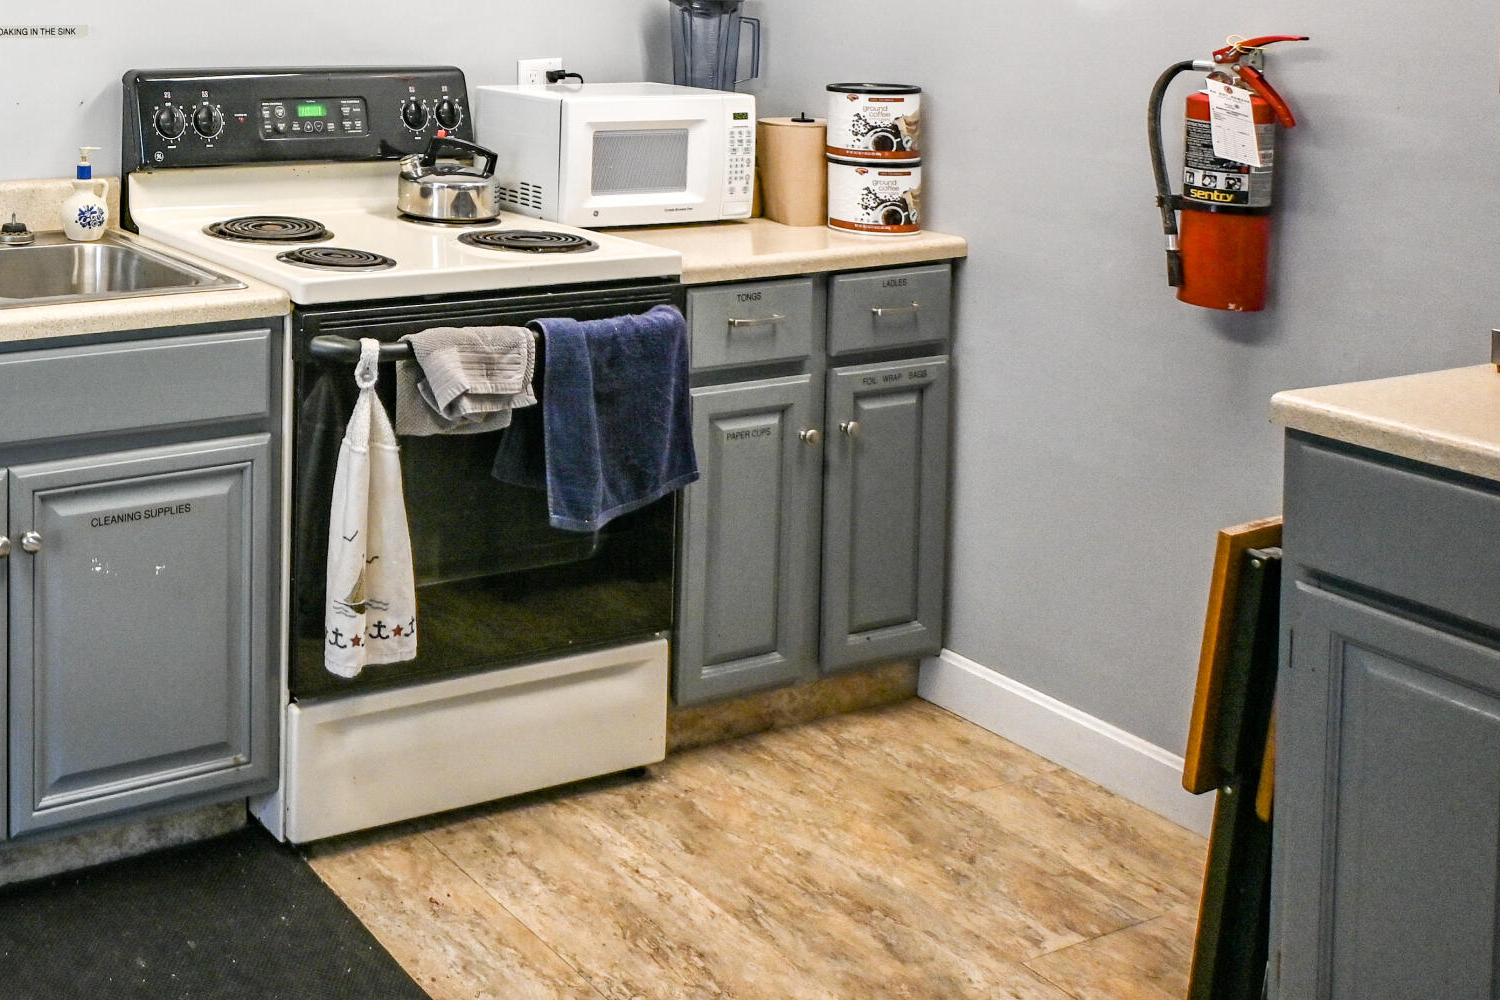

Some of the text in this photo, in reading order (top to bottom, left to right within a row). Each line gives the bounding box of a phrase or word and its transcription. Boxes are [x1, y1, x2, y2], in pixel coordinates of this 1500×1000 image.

[30, 28, 38, 36] IN
[40, 27, 56, 36] THE
[57, 27, 76, 36] SINK
[862, 105, 888, 113] ground
[872, 179, 897, 187] ground
[1190, 187, 1235, 202] sentry
[736, 291, 762, 301] TONGS
[882, 373, 902, 383] WRAP
[726, 430, 750, 441] PAPER
[90, 503, 191, 528] CLEANING SUPPLIES
